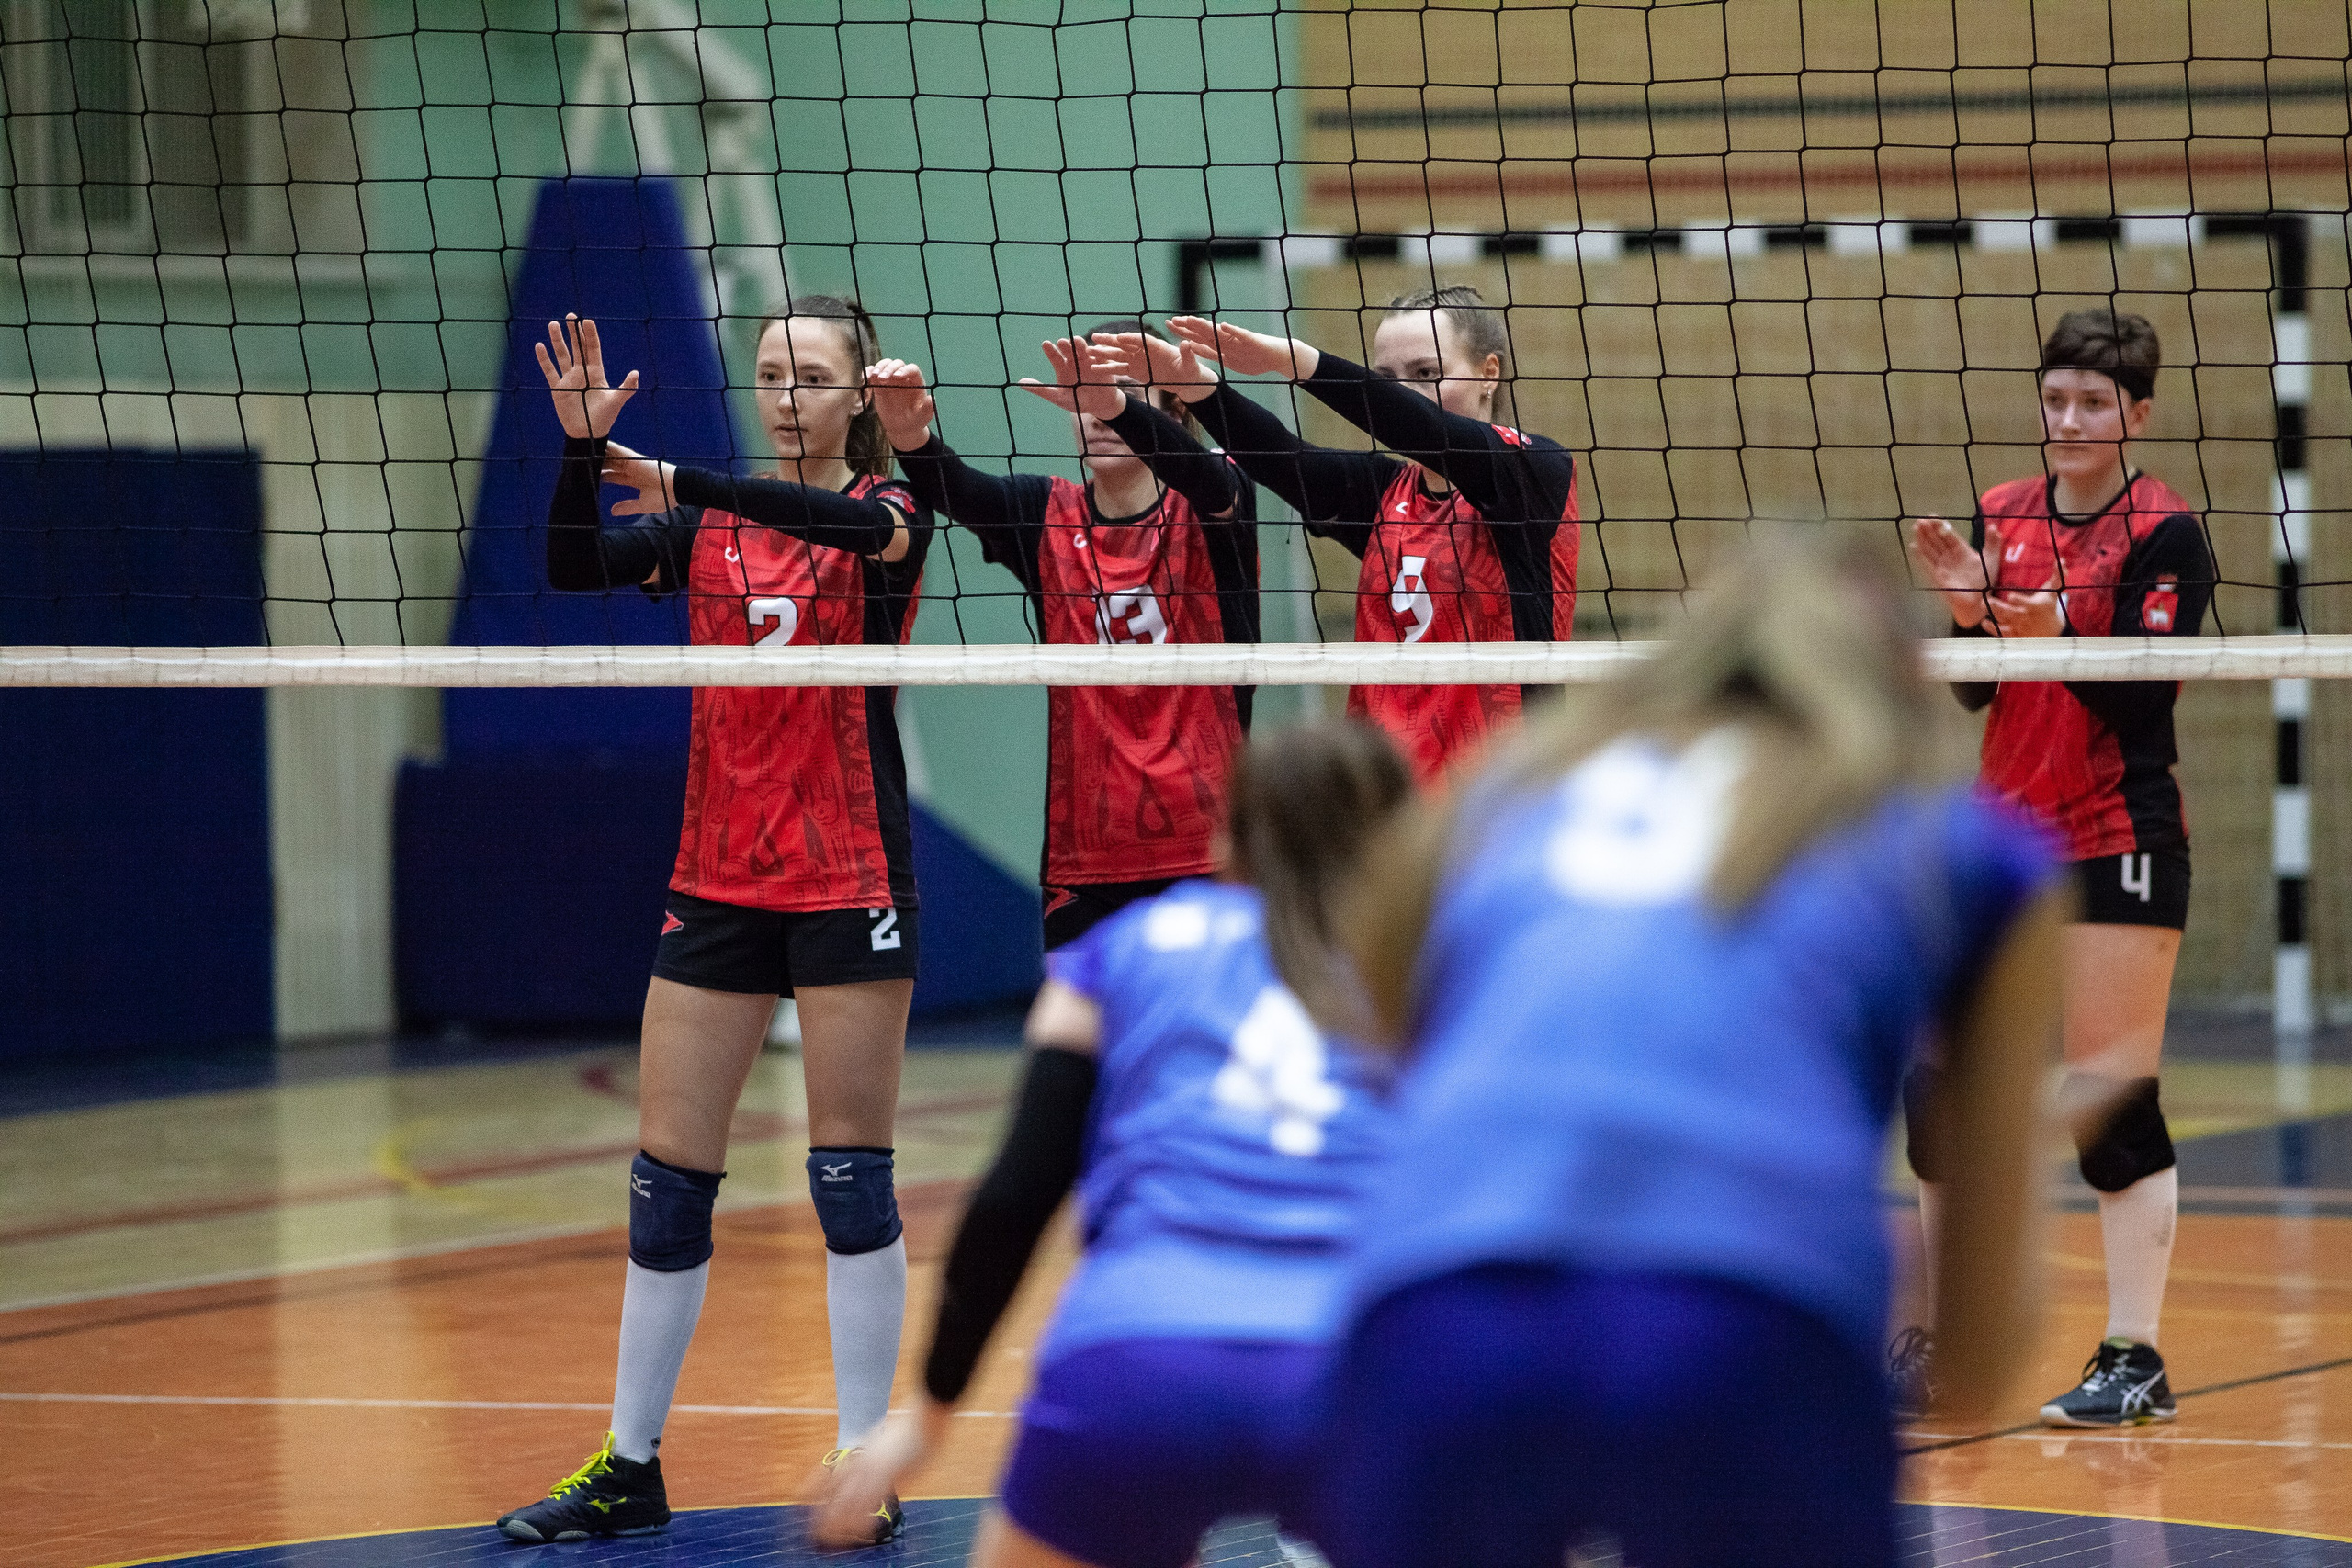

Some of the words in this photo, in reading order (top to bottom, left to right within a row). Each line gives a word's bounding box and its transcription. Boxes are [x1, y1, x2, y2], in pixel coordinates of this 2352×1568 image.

[748, 597, 797, 645] 2
[1091, 584, 1167, 644] 13
[2121, 853, 2151, 903] 4
[869, 907, 901, 951] 2
